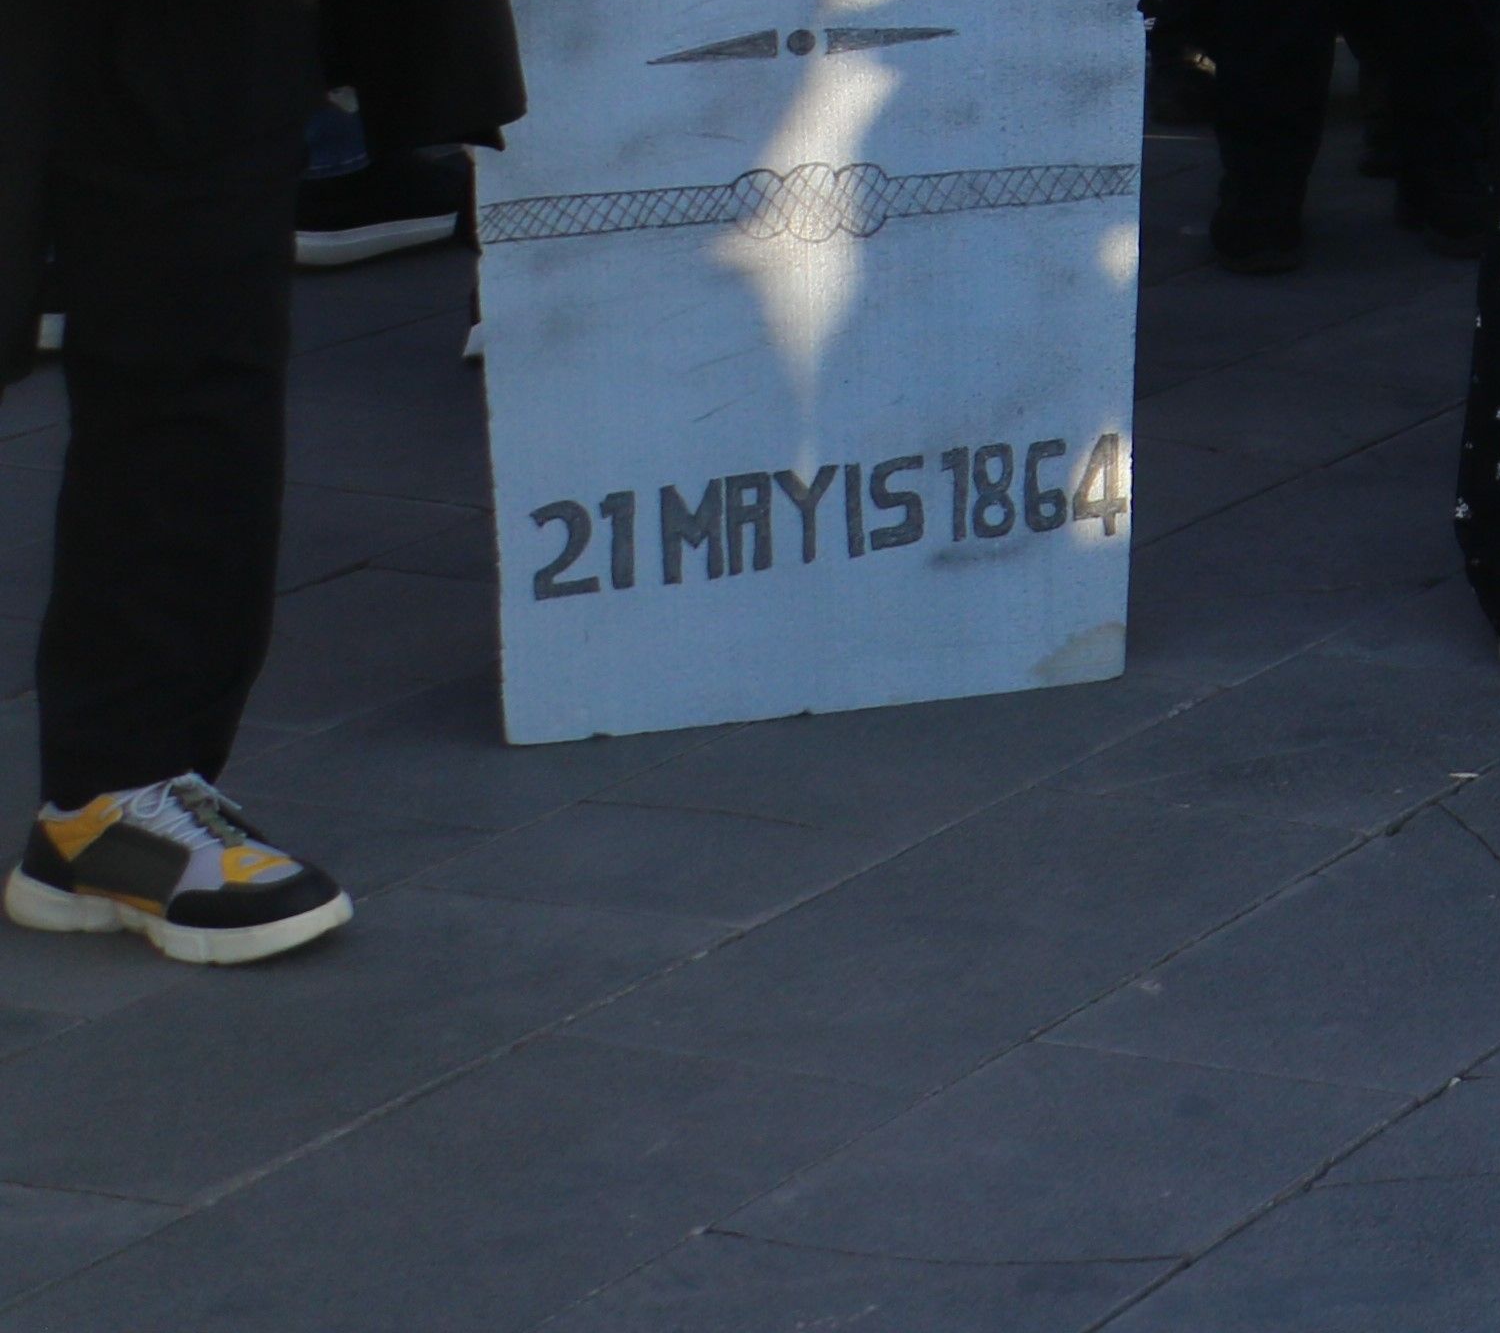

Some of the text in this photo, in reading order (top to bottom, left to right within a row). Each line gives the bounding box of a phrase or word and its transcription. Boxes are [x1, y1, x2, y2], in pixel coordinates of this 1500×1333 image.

[529, 433, 1128, 601] 21 MAYIS 1864
